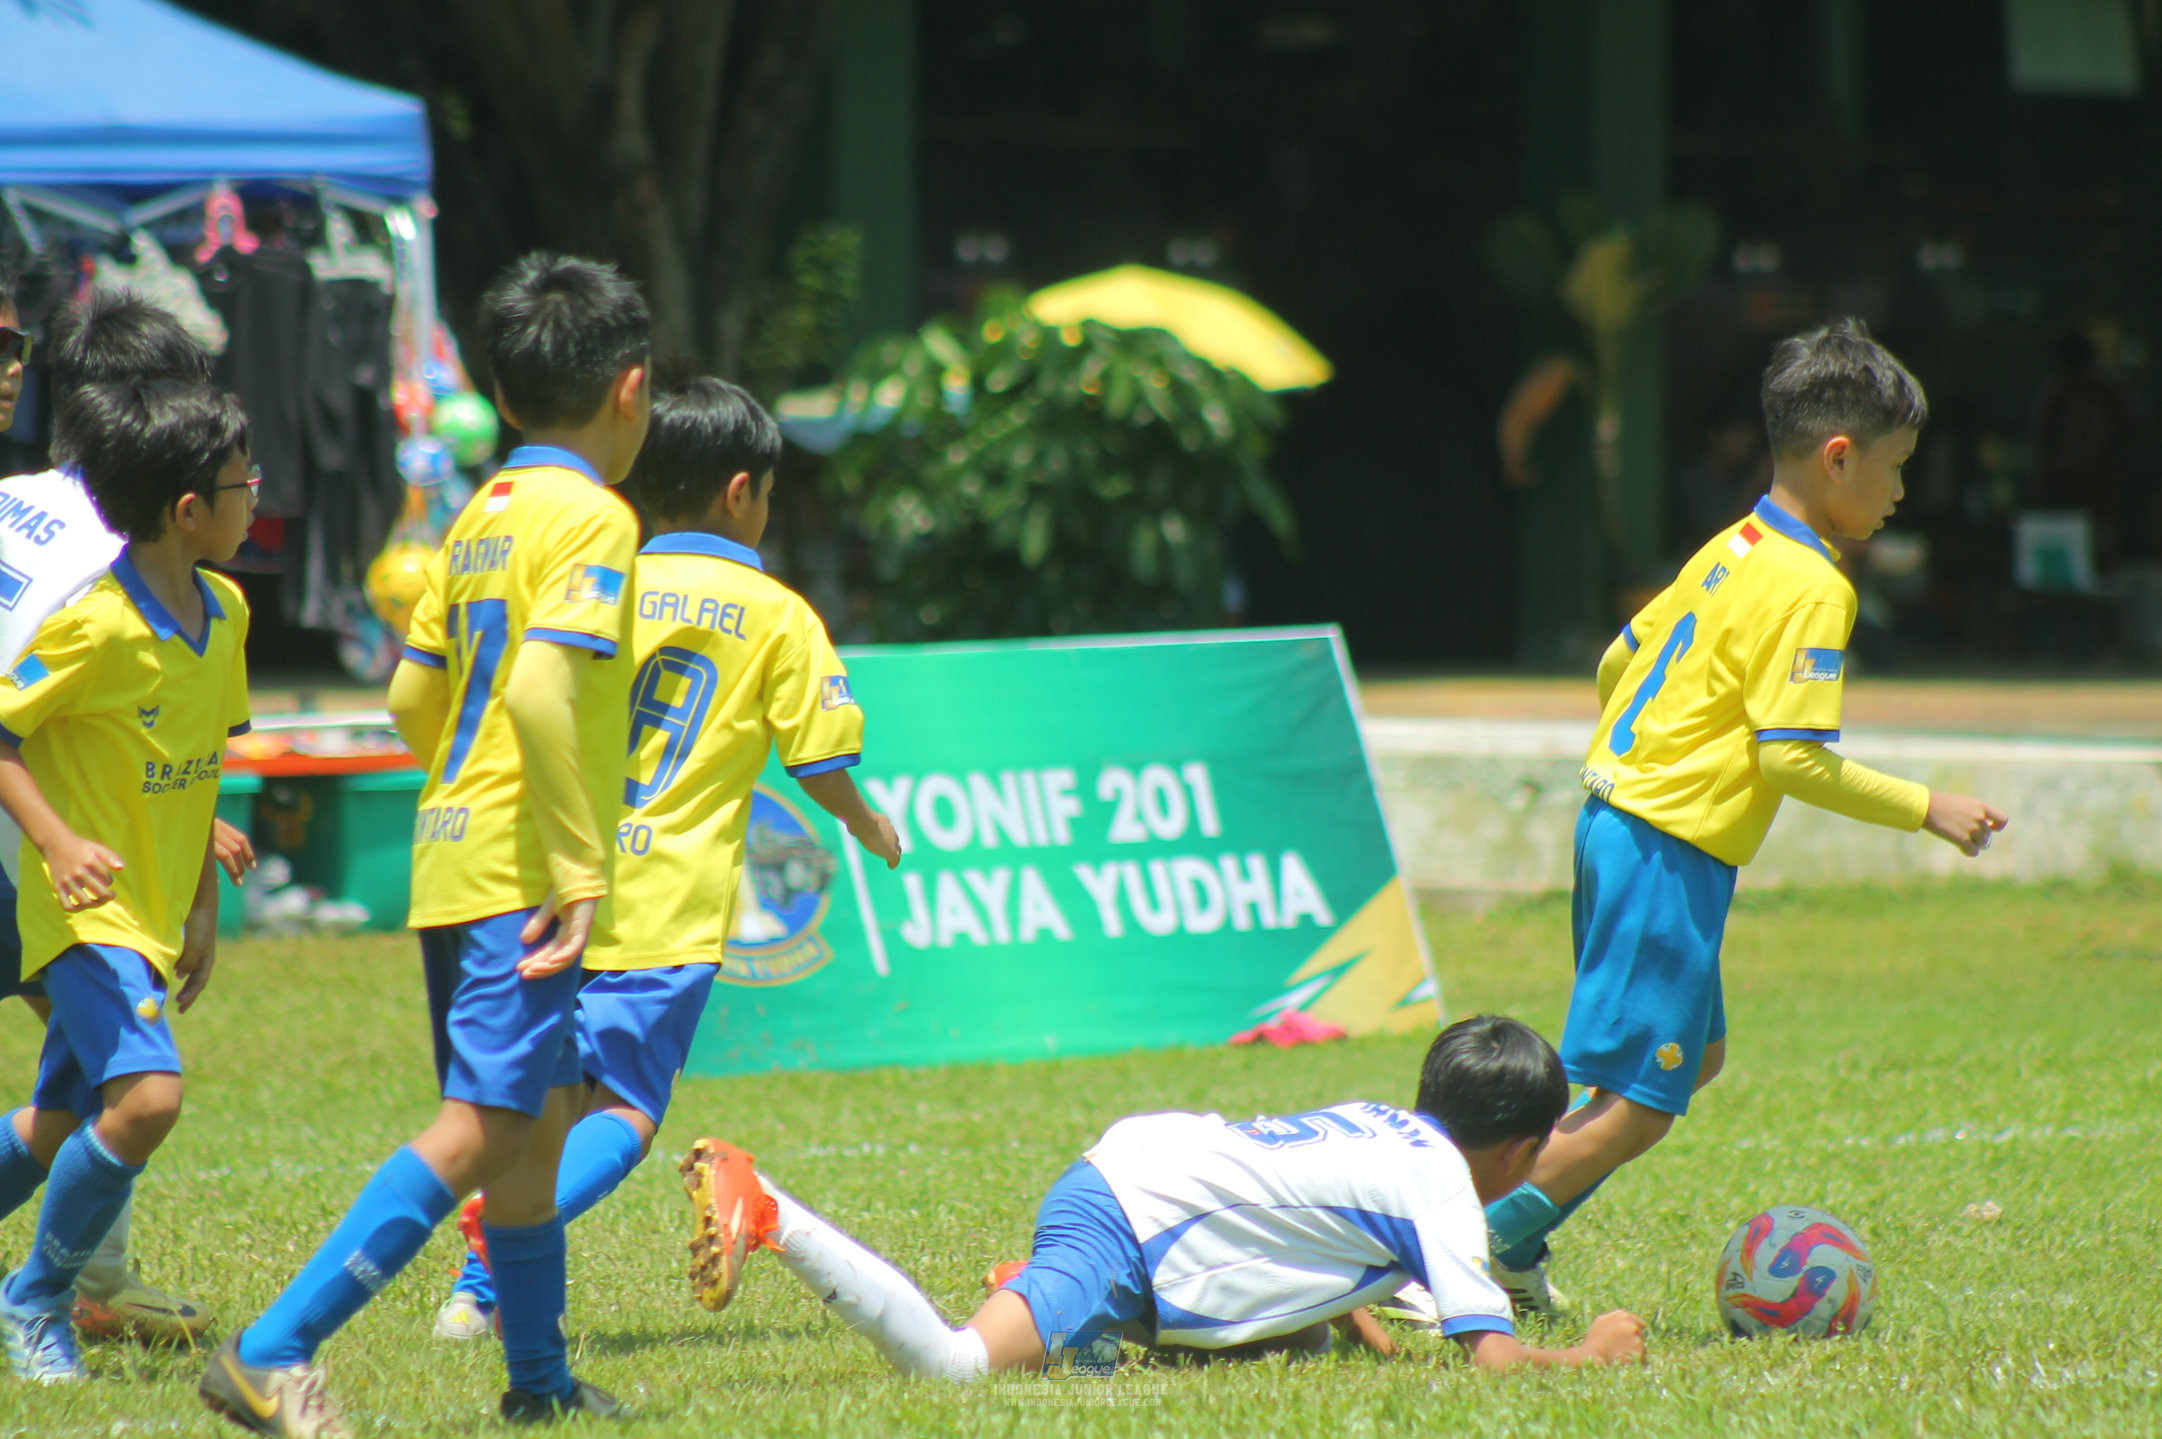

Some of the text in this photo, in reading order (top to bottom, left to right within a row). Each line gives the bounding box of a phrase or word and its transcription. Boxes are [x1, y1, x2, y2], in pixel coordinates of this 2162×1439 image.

[638, 591, 748, 642] GALAEL
[863, 761, 1222, 854] YONIF 201
[900, 849, 1336, 949] JAYA YUDHA
